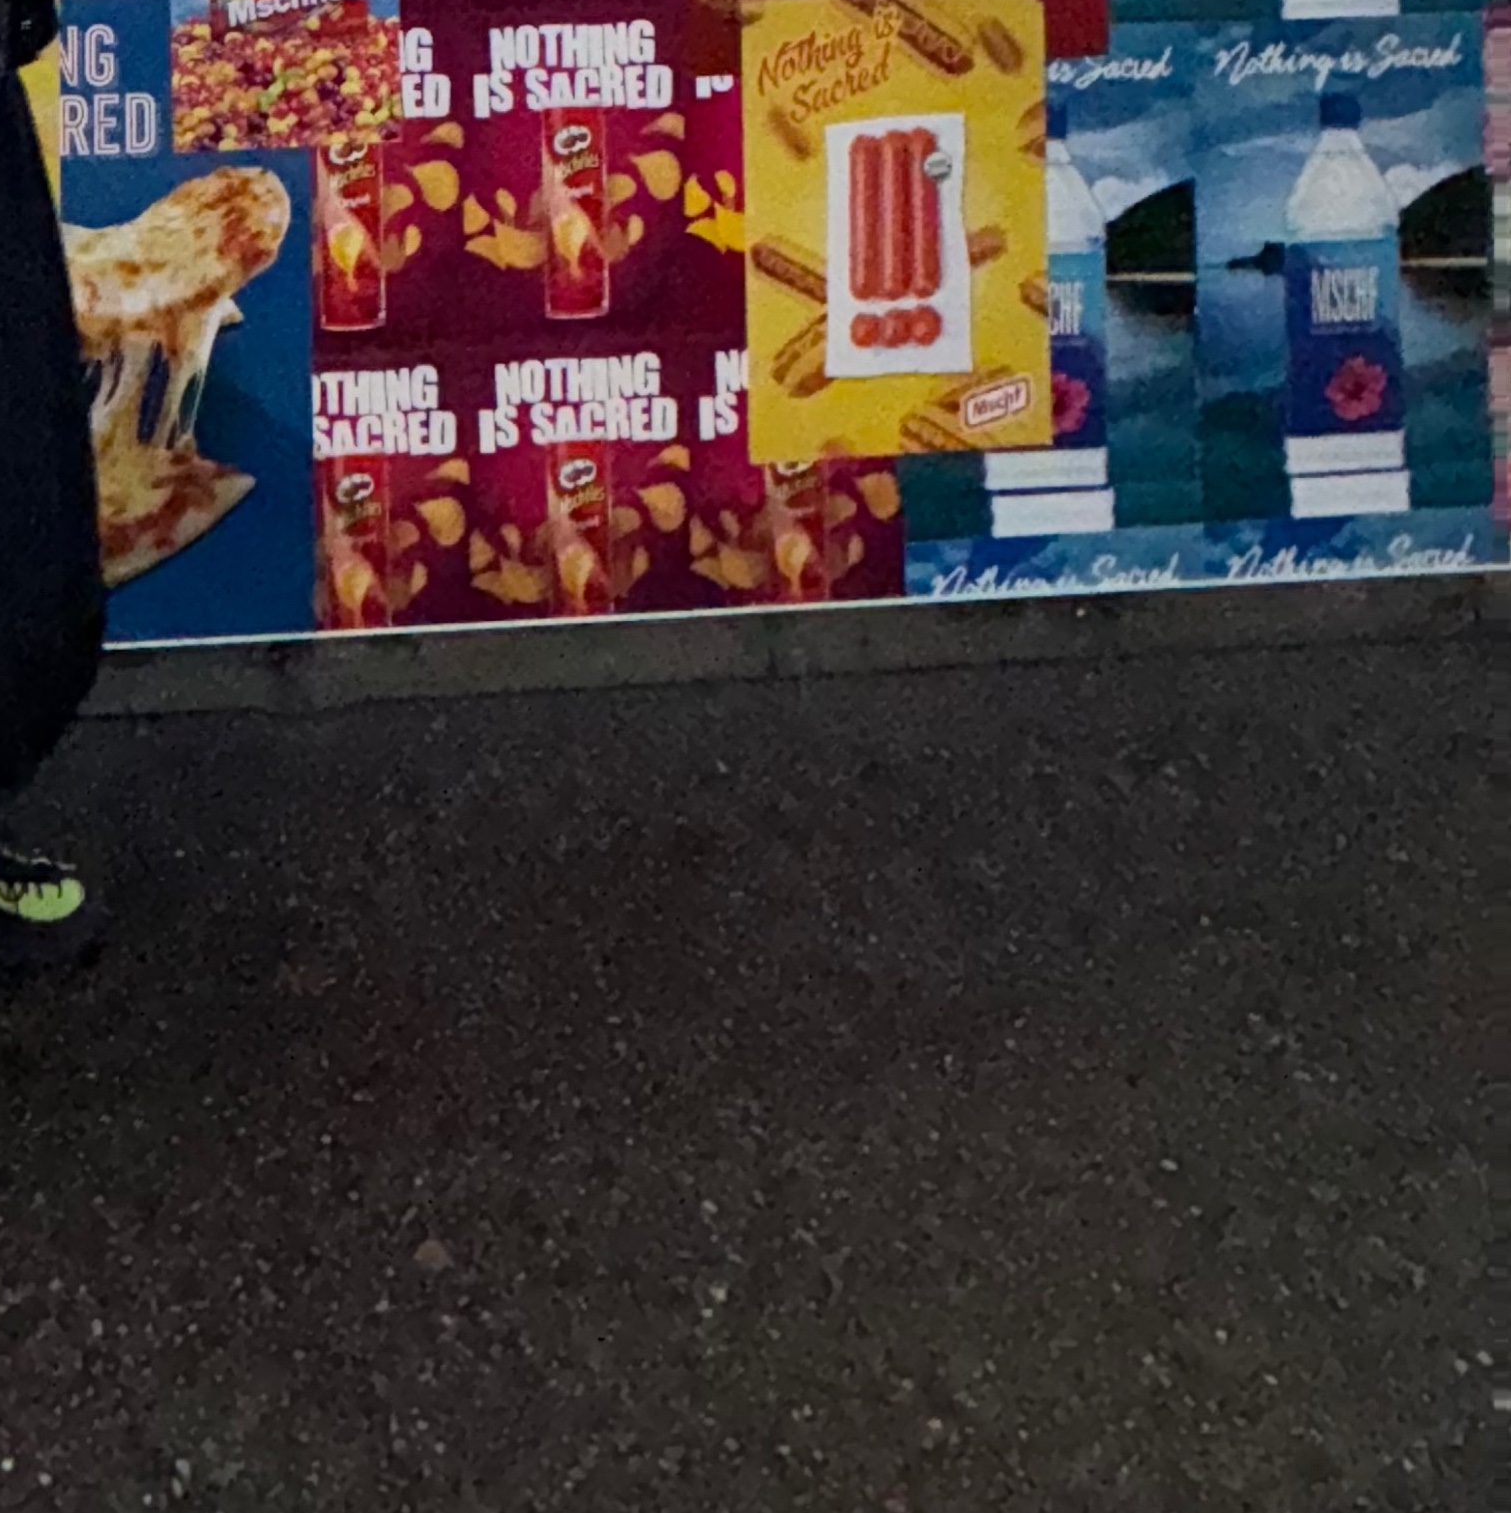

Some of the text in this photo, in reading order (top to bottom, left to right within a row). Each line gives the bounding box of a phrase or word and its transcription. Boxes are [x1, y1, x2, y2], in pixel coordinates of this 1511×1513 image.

[490, 20, 657, 71] NOTHING
[757, 30, 867, 96] Nothing
[873, 0, 904, 38] is
[1215, 33, 1463, 91] Nothing is Sacred
[472, 69, 515, 119] IS
[525, 65, 674, 110] SACRED
[789, 50, 892, 124] Sacred
[1310, 264, 1381, 324] MSCHF
[494, 351, 662, 406] NOTHING
[478, 396, 679, 454] IS SACRED
[698, 392, 739, 441] IS
